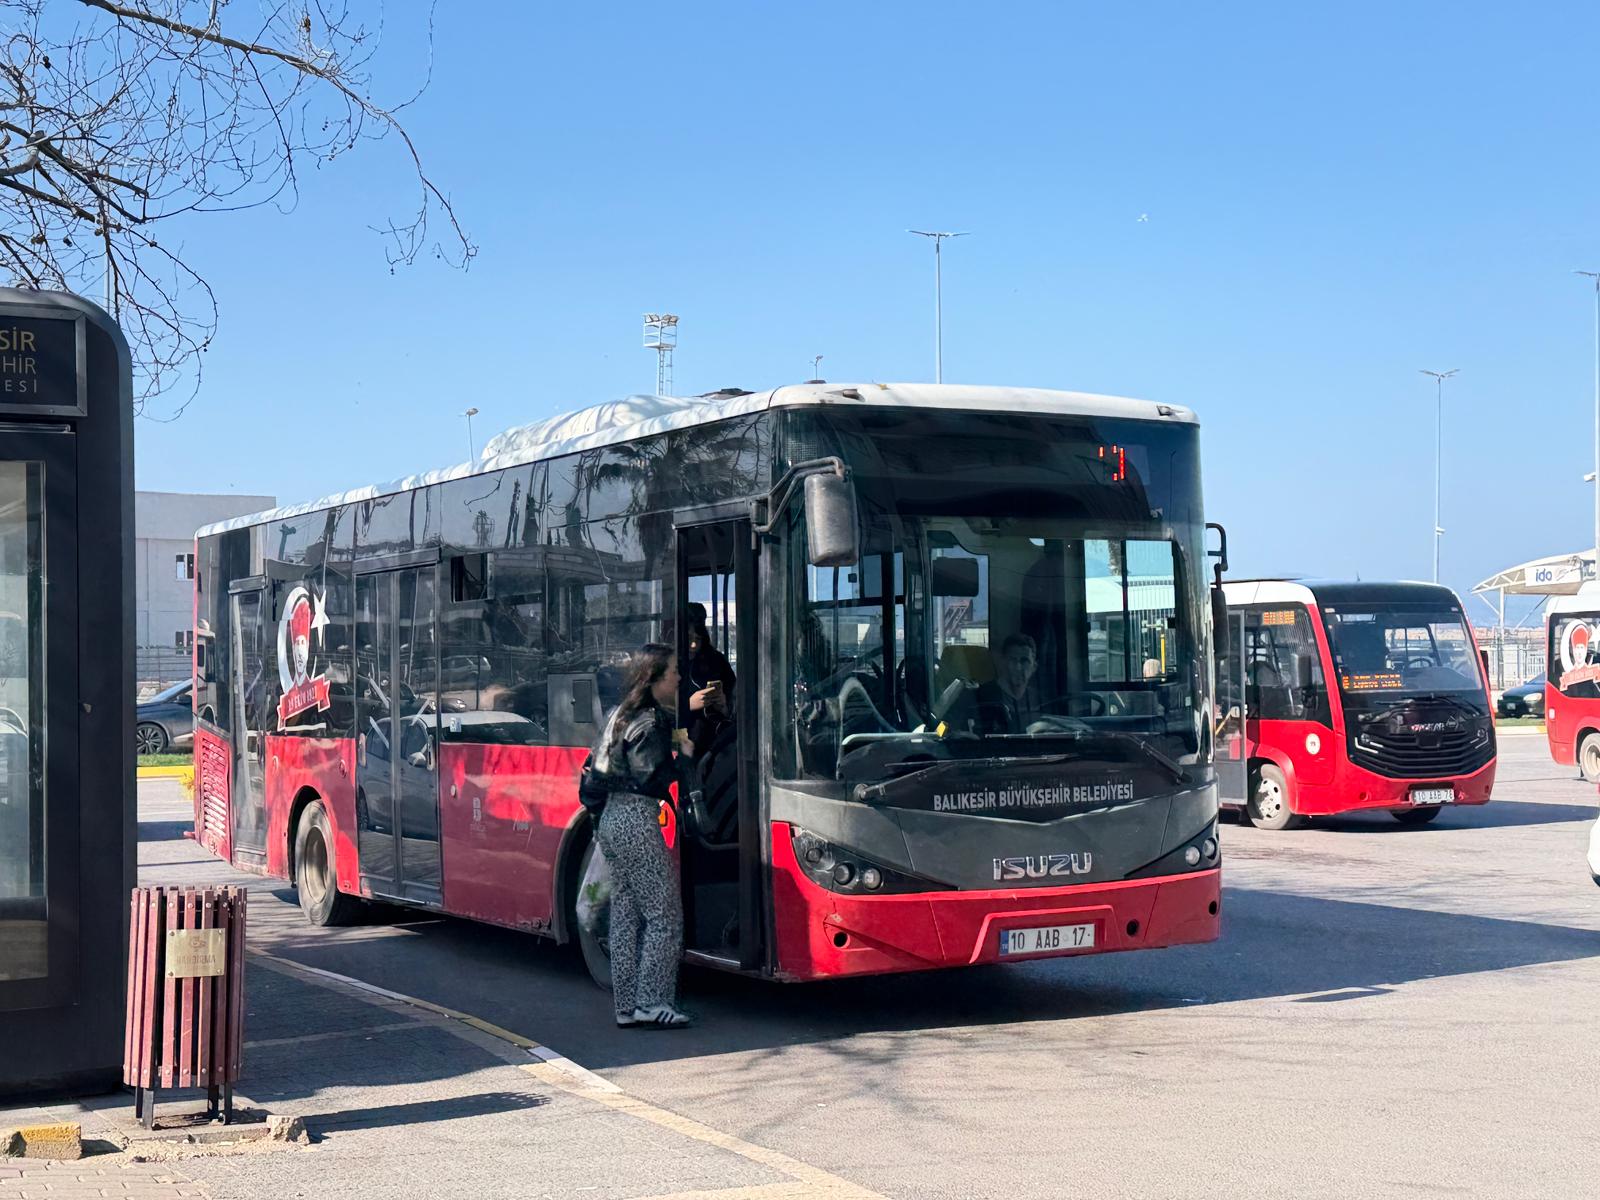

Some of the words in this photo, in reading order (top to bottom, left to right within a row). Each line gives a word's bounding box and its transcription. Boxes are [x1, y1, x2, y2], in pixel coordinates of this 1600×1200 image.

[934, 787, 996, 811] BALIKESİR
[999, 783, 1071, 807] BÜYÜKŞEHİR
[1073, 780, 1133, 802] BELEDİYESİ
[993, 852, 1092, 881] ISUZU
[1011, 932, 1025, 951] 10
[1035, 929, 1060, 949] AAB
[1072, 927, 1086, 946] 17
